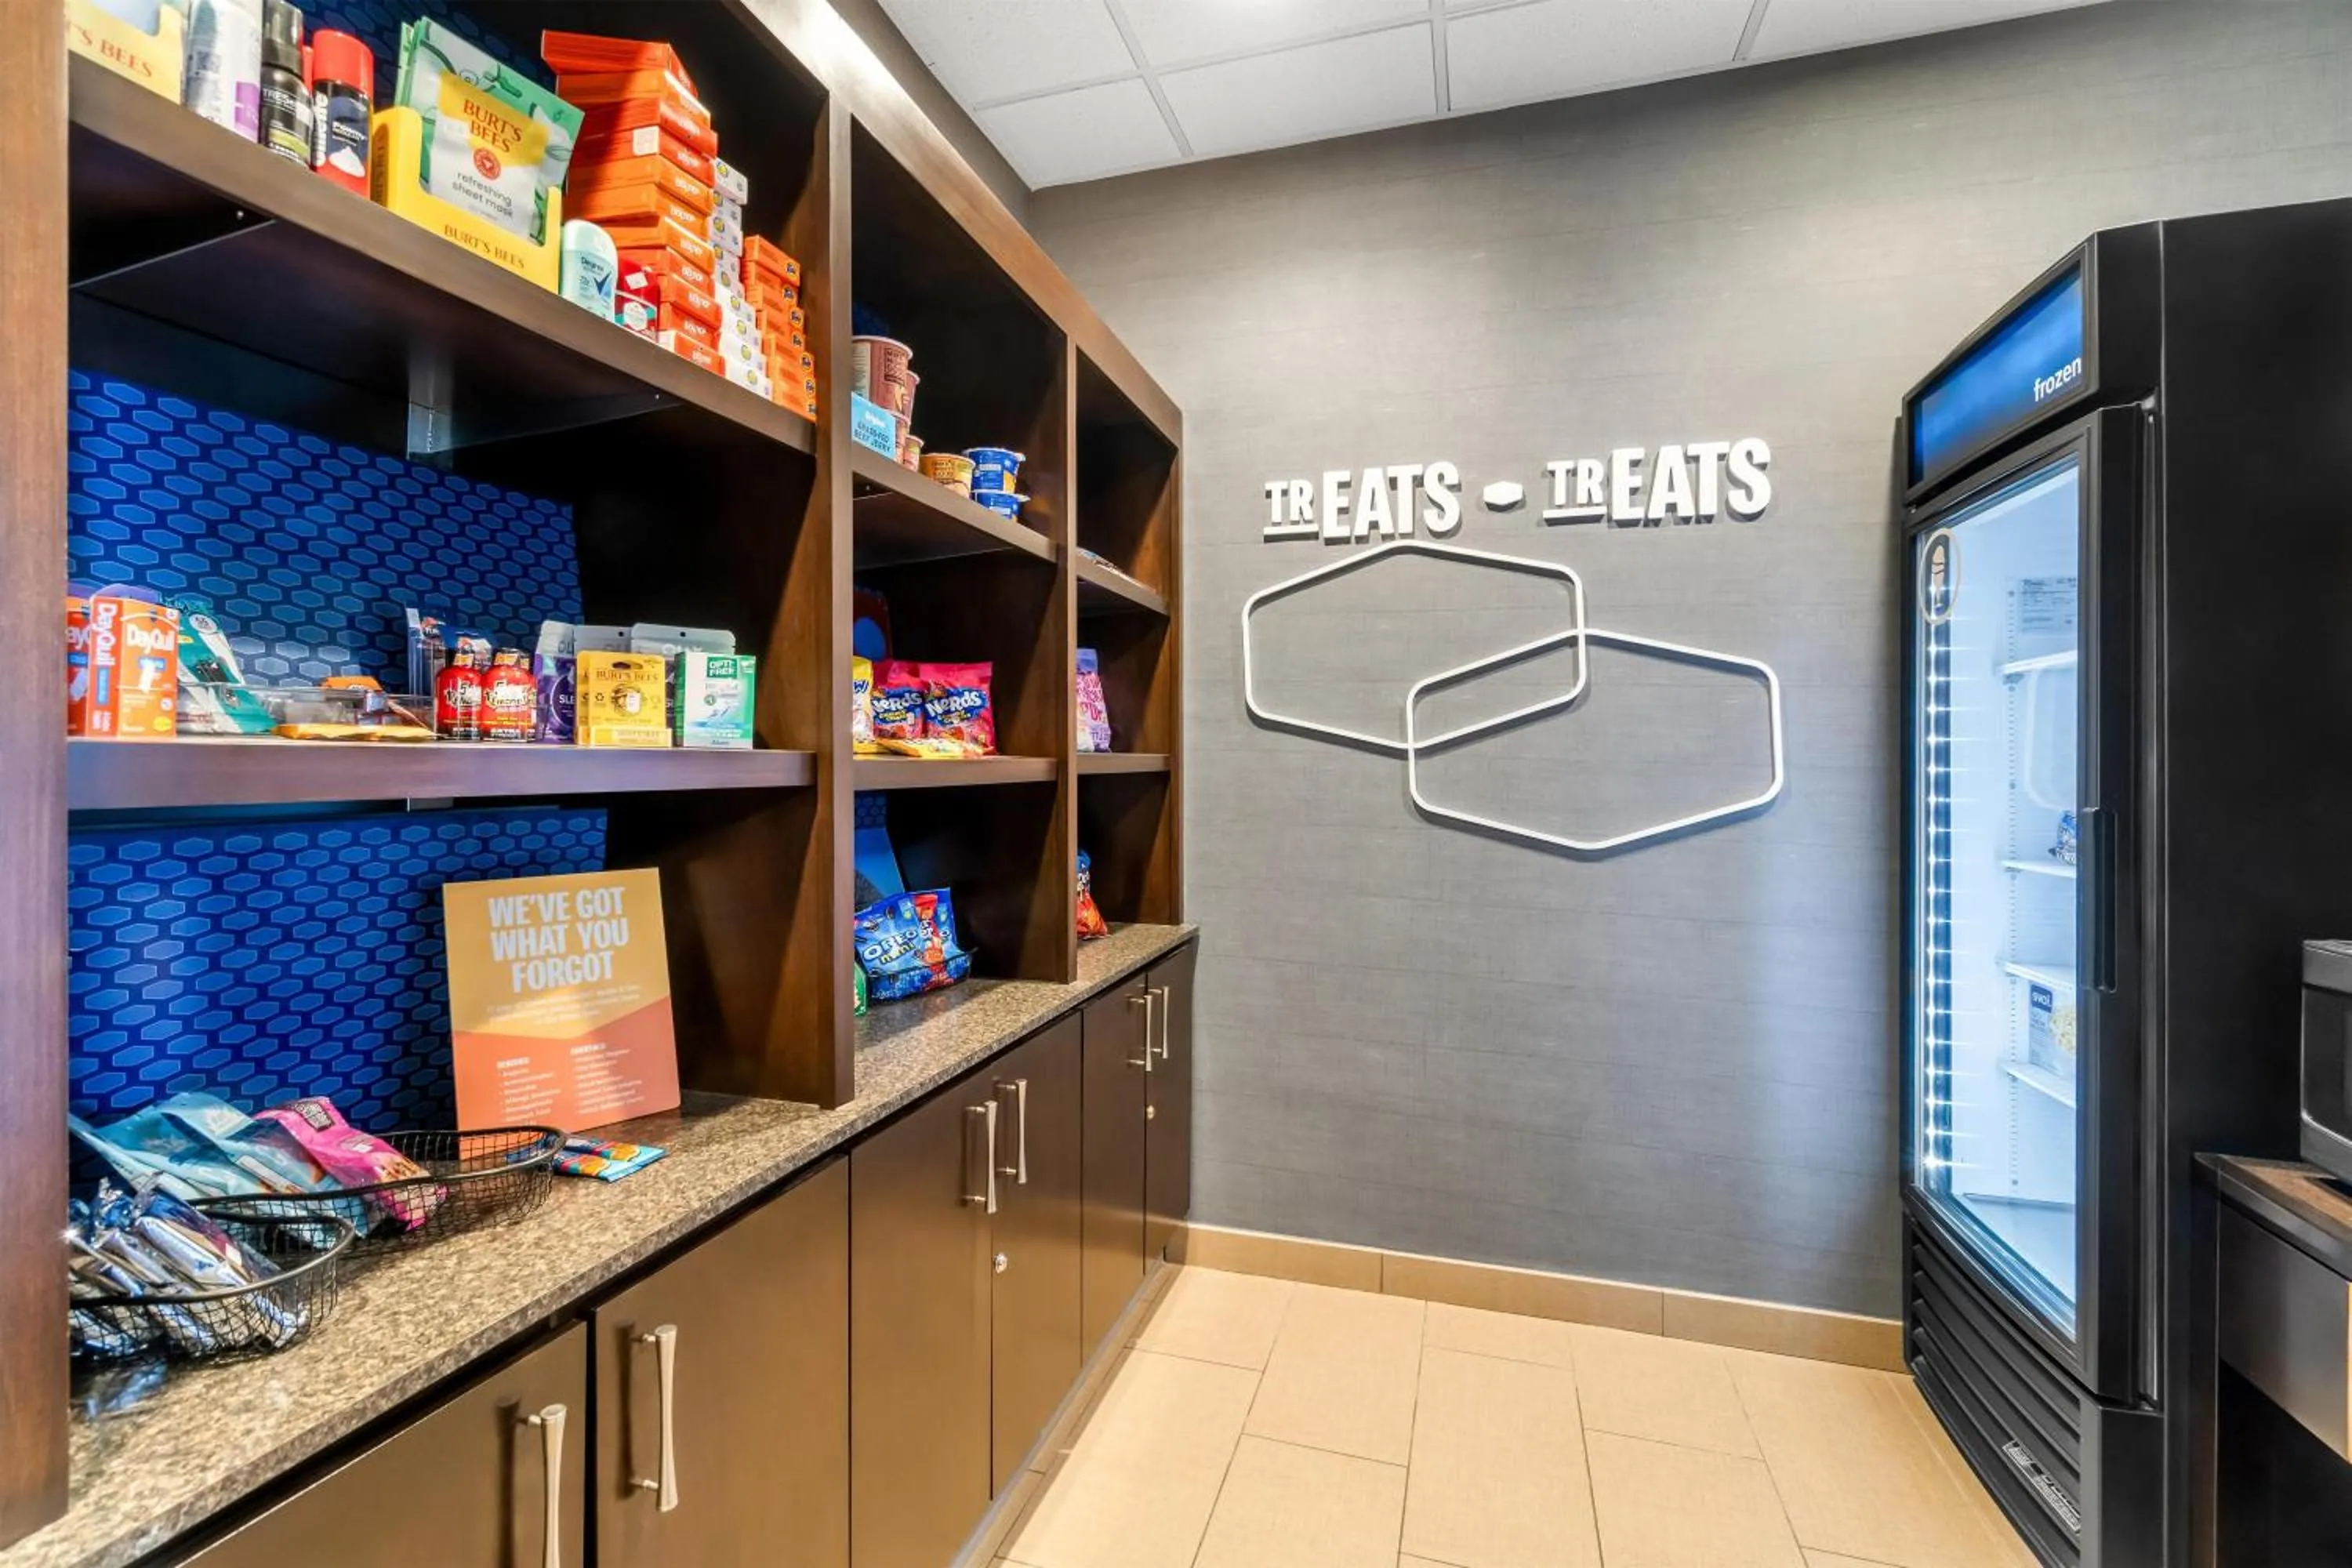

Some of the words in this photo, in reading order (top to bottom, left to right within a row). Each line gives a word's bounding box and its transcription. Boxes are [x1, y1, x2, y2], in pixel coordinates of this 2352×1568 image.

[463, 99, 523, 141] BURT'S
[470, 120, 510, 153] BEES
[452, 182, 484, 202] sheet
[485, 198, 514, 218] mask
[457, 172, 512, 208] refreshing
[444, 224, 491, 253] BURT'S
[495, 245, 525, 270] BEES
[2033, 357, 2082, 402] frozen
[1264, 461, 1461, 541] TREATS
[1542, 437, 1772, 527] TREATS
[93, 603, 118, 666] DayQuil
[127, 623, 175, 655] DayQuil
[488, 891, 572, 928] WE'VE
[575, 886, 626, 919] GOT
[490, 923, 569, 963] WHAT
[575, 916, 630, 951] YOU
[863, 928, 918, 961] OREO
[511, 949, 615, 994] FORGOT
